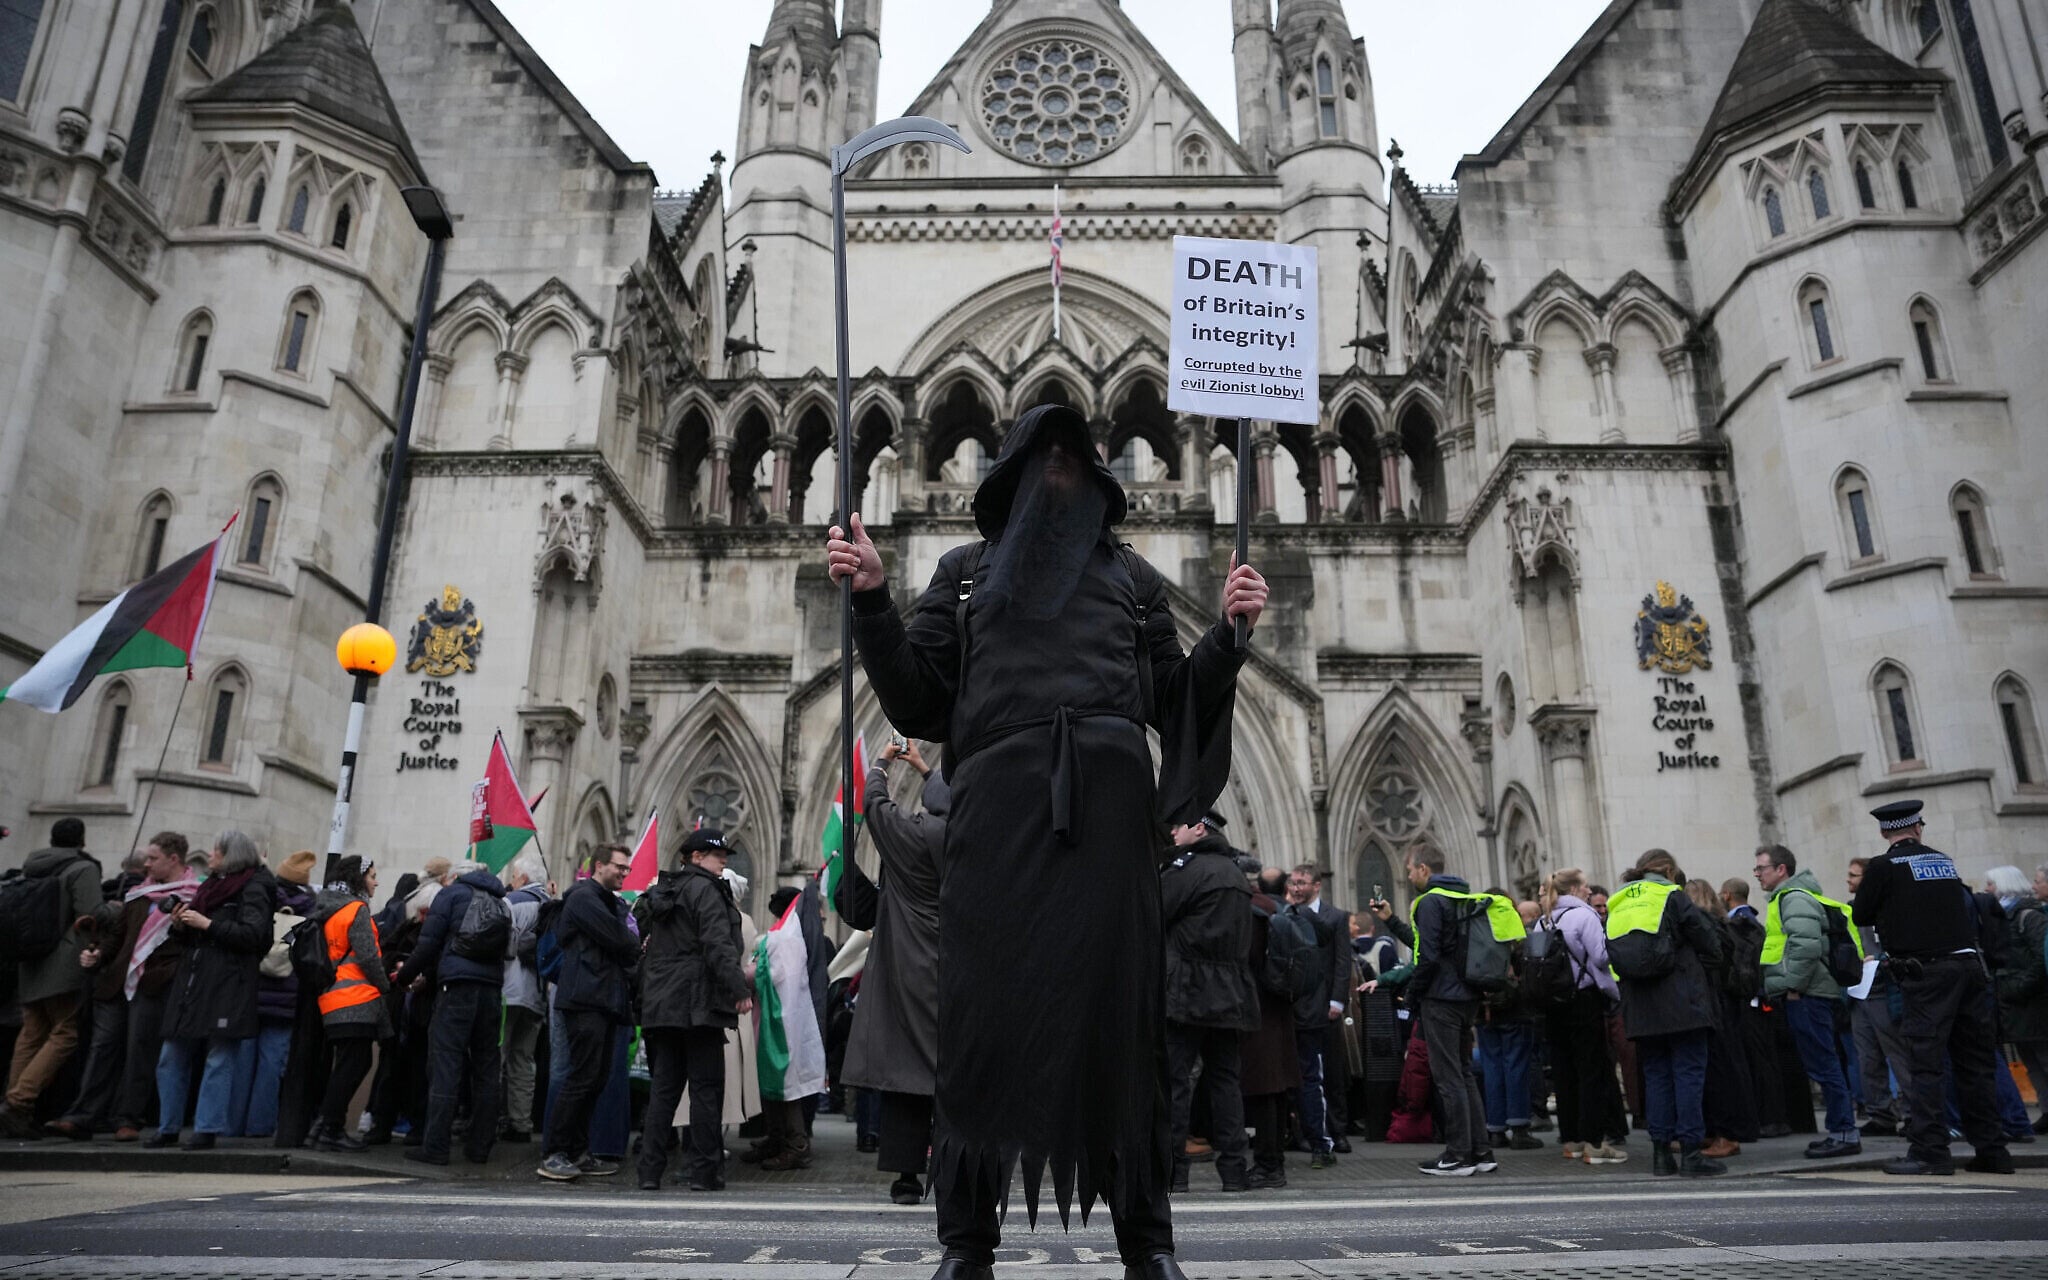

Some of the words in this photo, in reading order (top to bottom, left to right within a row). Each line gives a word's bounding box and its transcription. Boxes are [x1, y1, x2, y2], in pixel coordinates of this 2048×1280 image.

[1187, 256, 1302, 290] DEATH
[1183, 295, 1208, 312] of
[1213, 297, 1305, 321] Britain’s
[1192, 323, 1295, 351] integrity!
[1184, 357, 1255, 373] Corrupted
[1259, 363, 1276, 377] by
[1279, 365, 1302, 377] the
[1181, 378, 1205, 390] evil
[1209, 379, 1256, 394] Zionist
[1260, 383, 1304, 399] lobby!
[421, 681, 455, 698] The
[1658, 677, 1694, 694] The
[410, 699, 459, 718] Royal
[1653, 696, 1706, 715] Royal
[403, 717, 462, 734] Courts
[1653, 715, 1714, 731] Courts
[420, 734, 442, 751] of
[1675, 732, 1696, 750] of
[396, 752, 459, 773] Justice
[1657, 752, 1720, 773] Justice
[1914, 865, 1956, 878] POLICE
